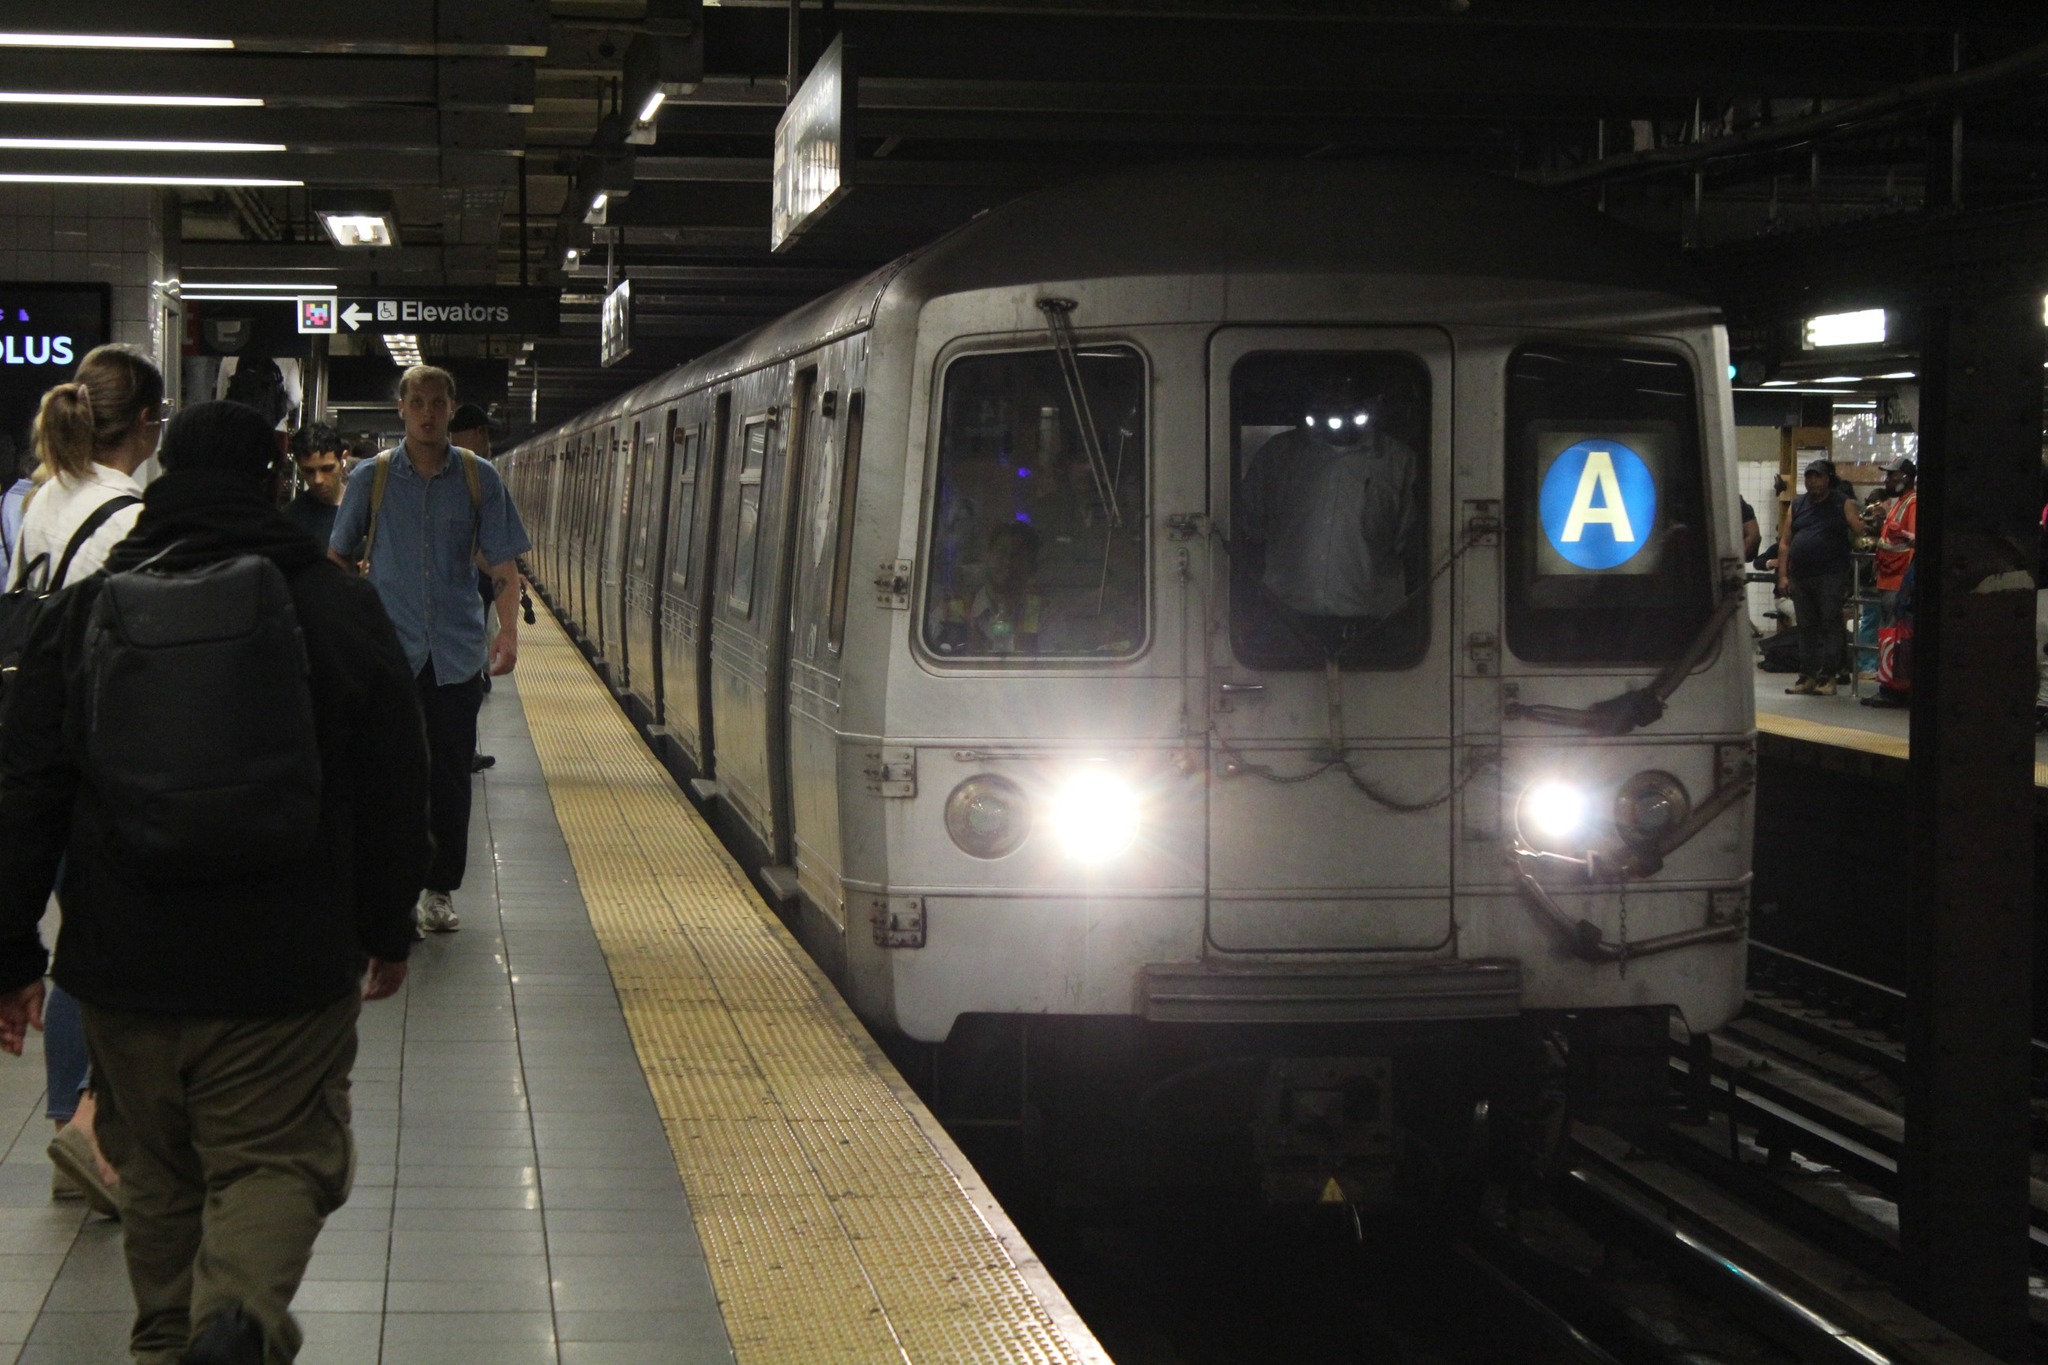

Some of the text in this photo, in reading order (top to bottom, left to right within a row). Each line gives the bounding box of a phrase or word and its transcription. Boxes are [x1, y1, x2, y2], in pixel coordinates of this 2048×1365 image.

[402, 301, 509, 322] Elevators
[0, 335, 74, 365] LUS
[1560, 452, 1635, 542] A
